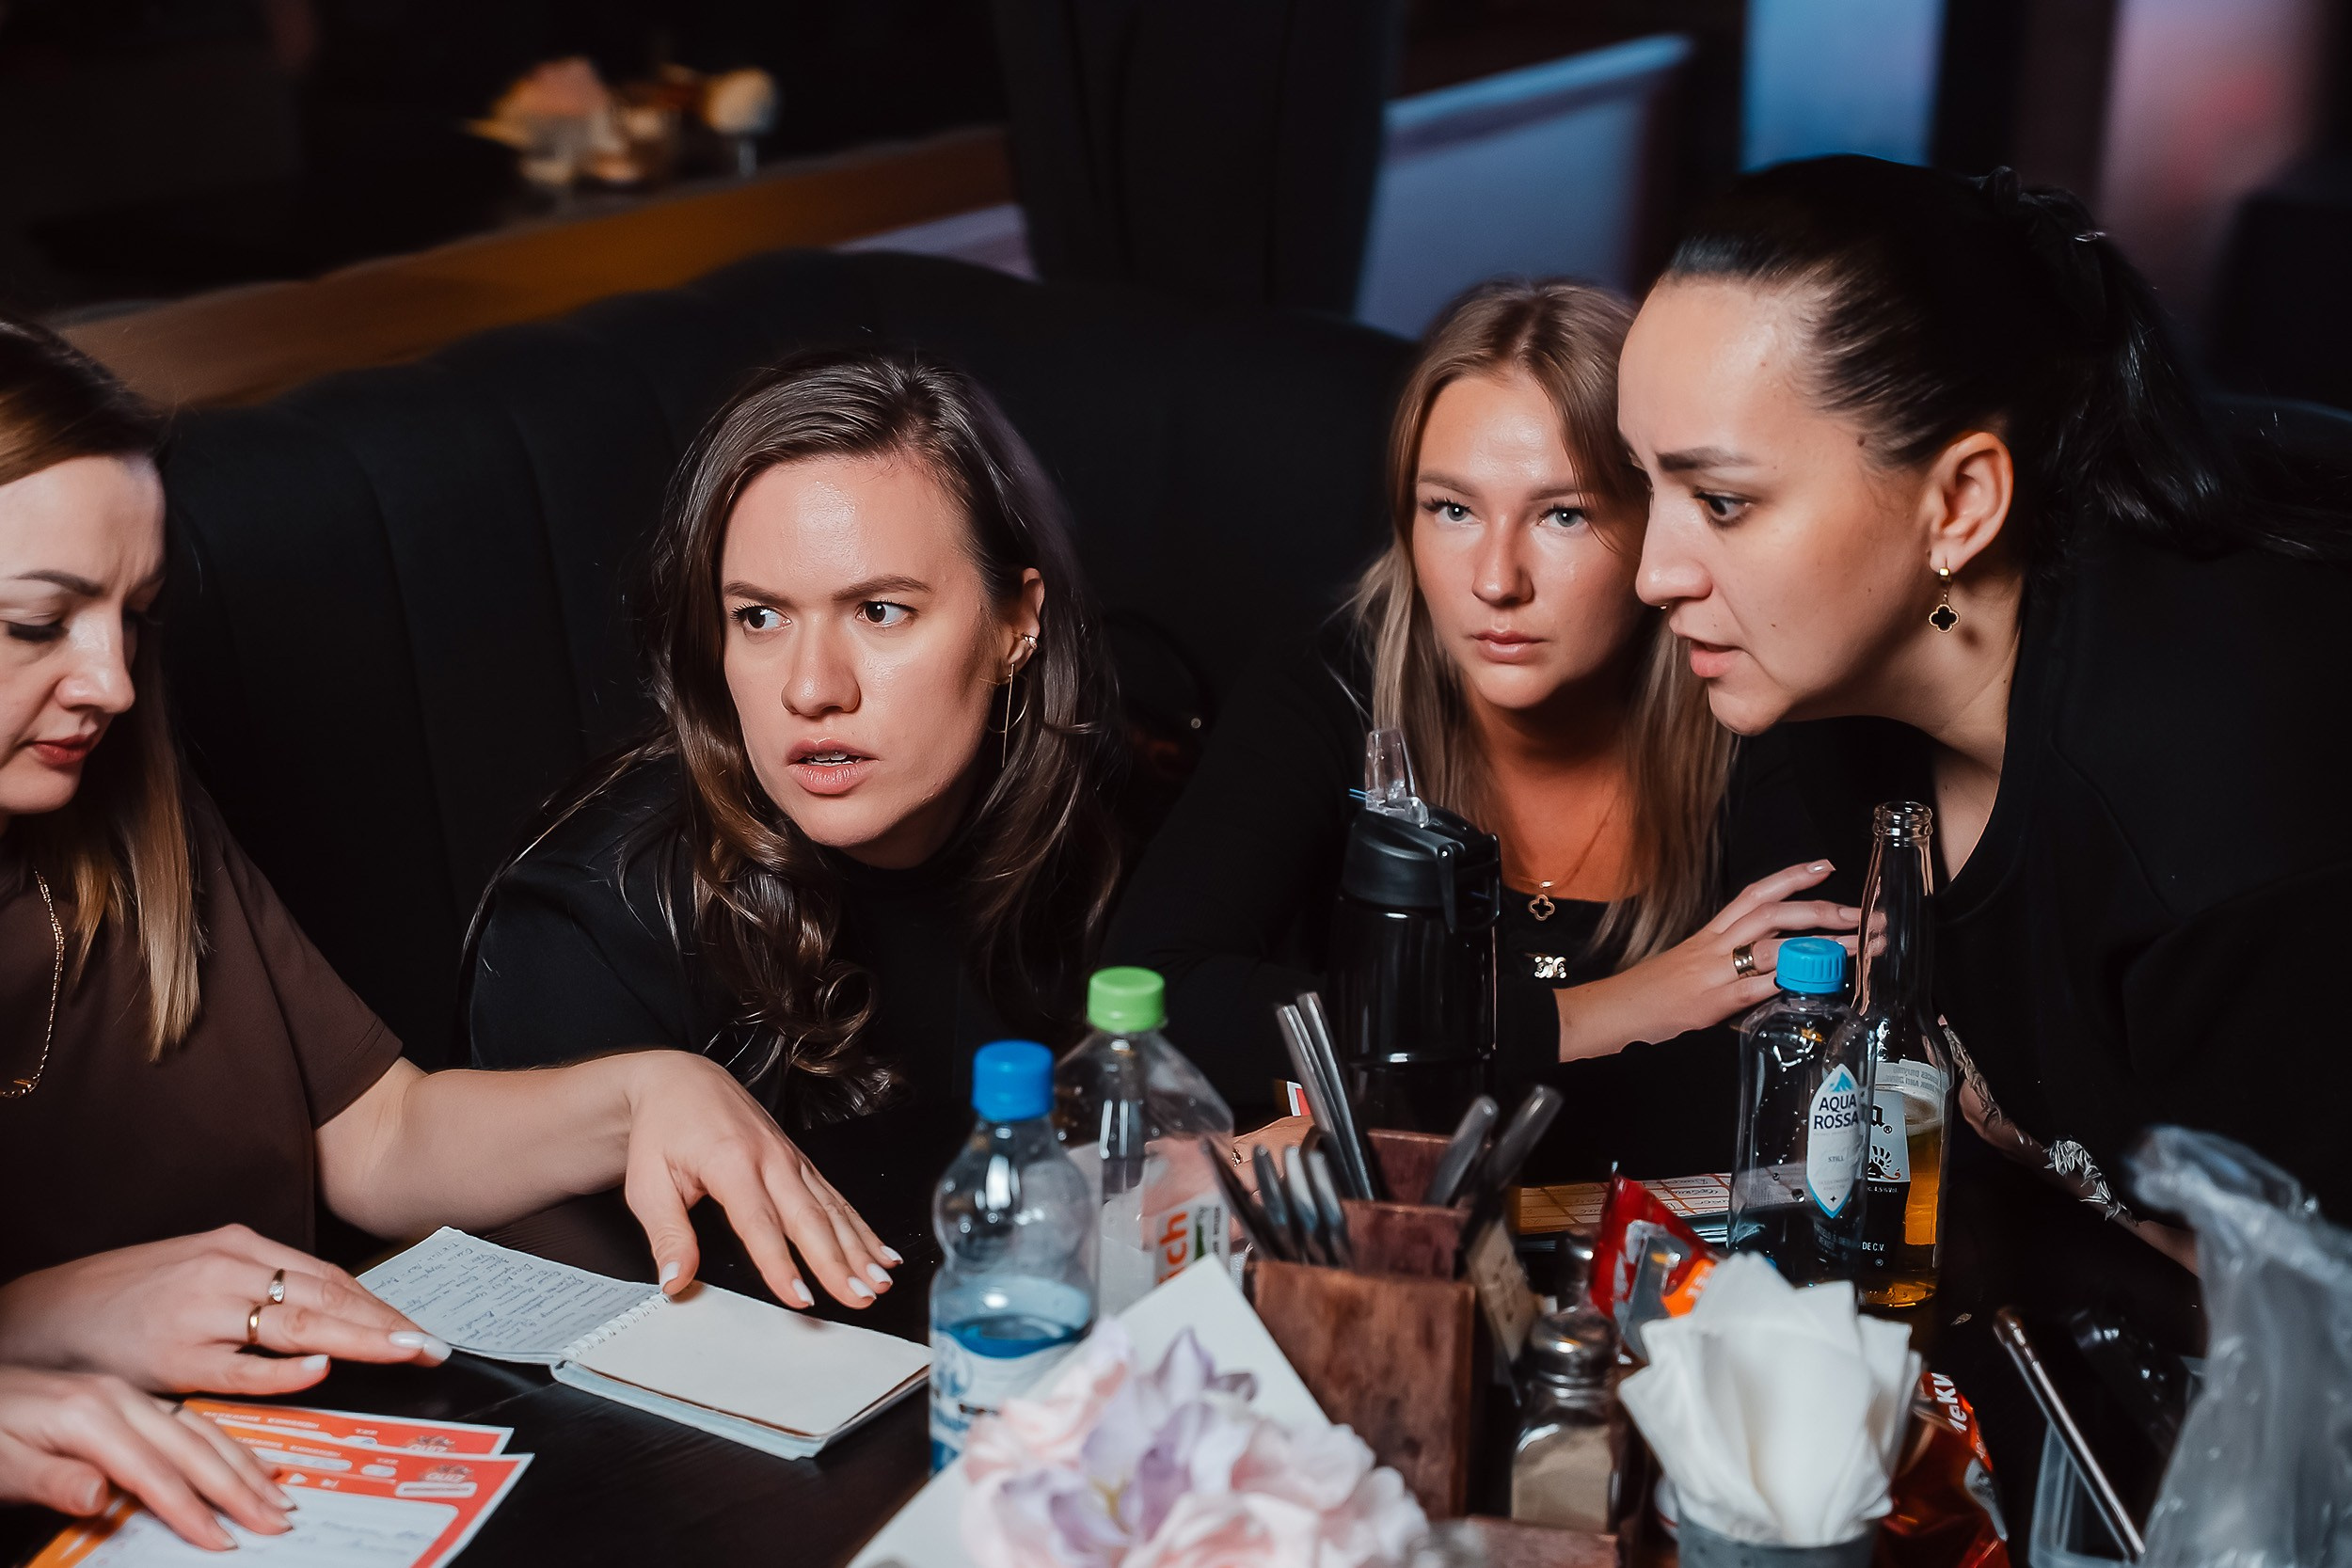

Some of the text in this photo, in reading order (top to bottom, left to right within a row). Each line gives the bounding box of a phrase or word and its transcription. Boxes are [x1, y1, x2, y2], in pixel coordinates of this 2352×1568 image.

[1819, 1094, 1857, 1113] AQUA
[1814, 1111, 1859, 1130] ROSSA
[1862, 1242, 1885, 1252] DE C.V.
